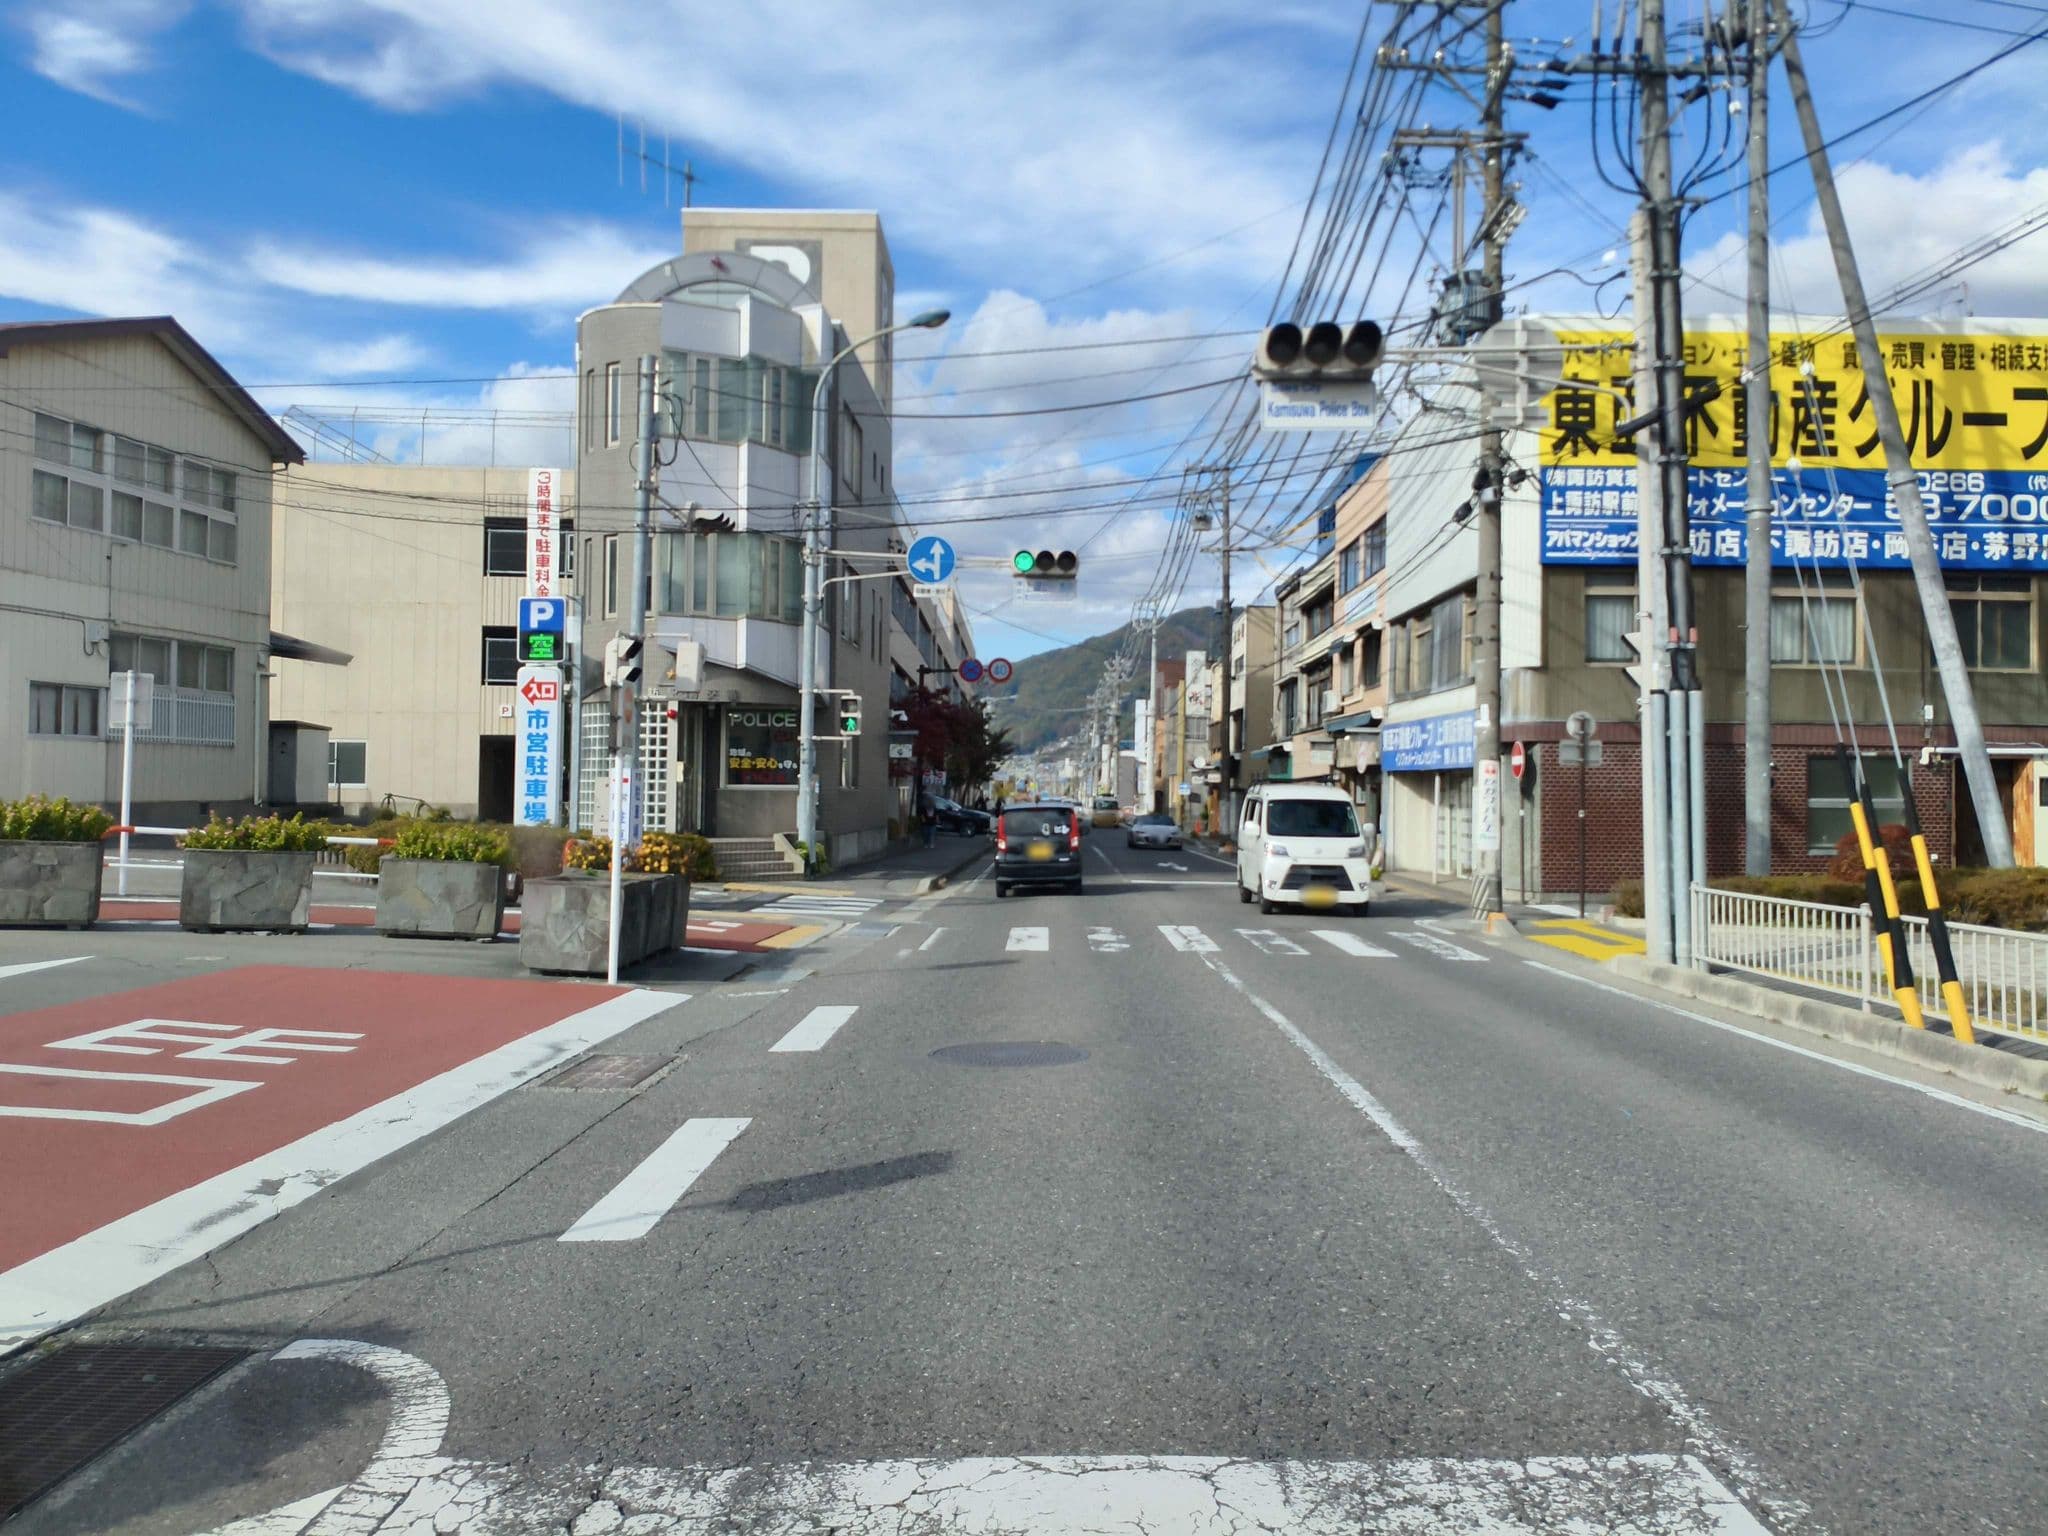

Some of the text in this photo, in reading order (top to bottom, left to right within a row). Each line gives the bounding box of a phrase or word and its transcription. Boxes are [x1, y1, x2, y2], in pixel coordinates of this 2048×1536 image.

[1267, 400, 1369, 417] Kamisuwa Police Box
[529, 601, 554, 629] P
[528, 682, 555, 698] 入口
[731, 712, 798, 728] POLICE
[524, 709, 550, 822] 市営駐車場
